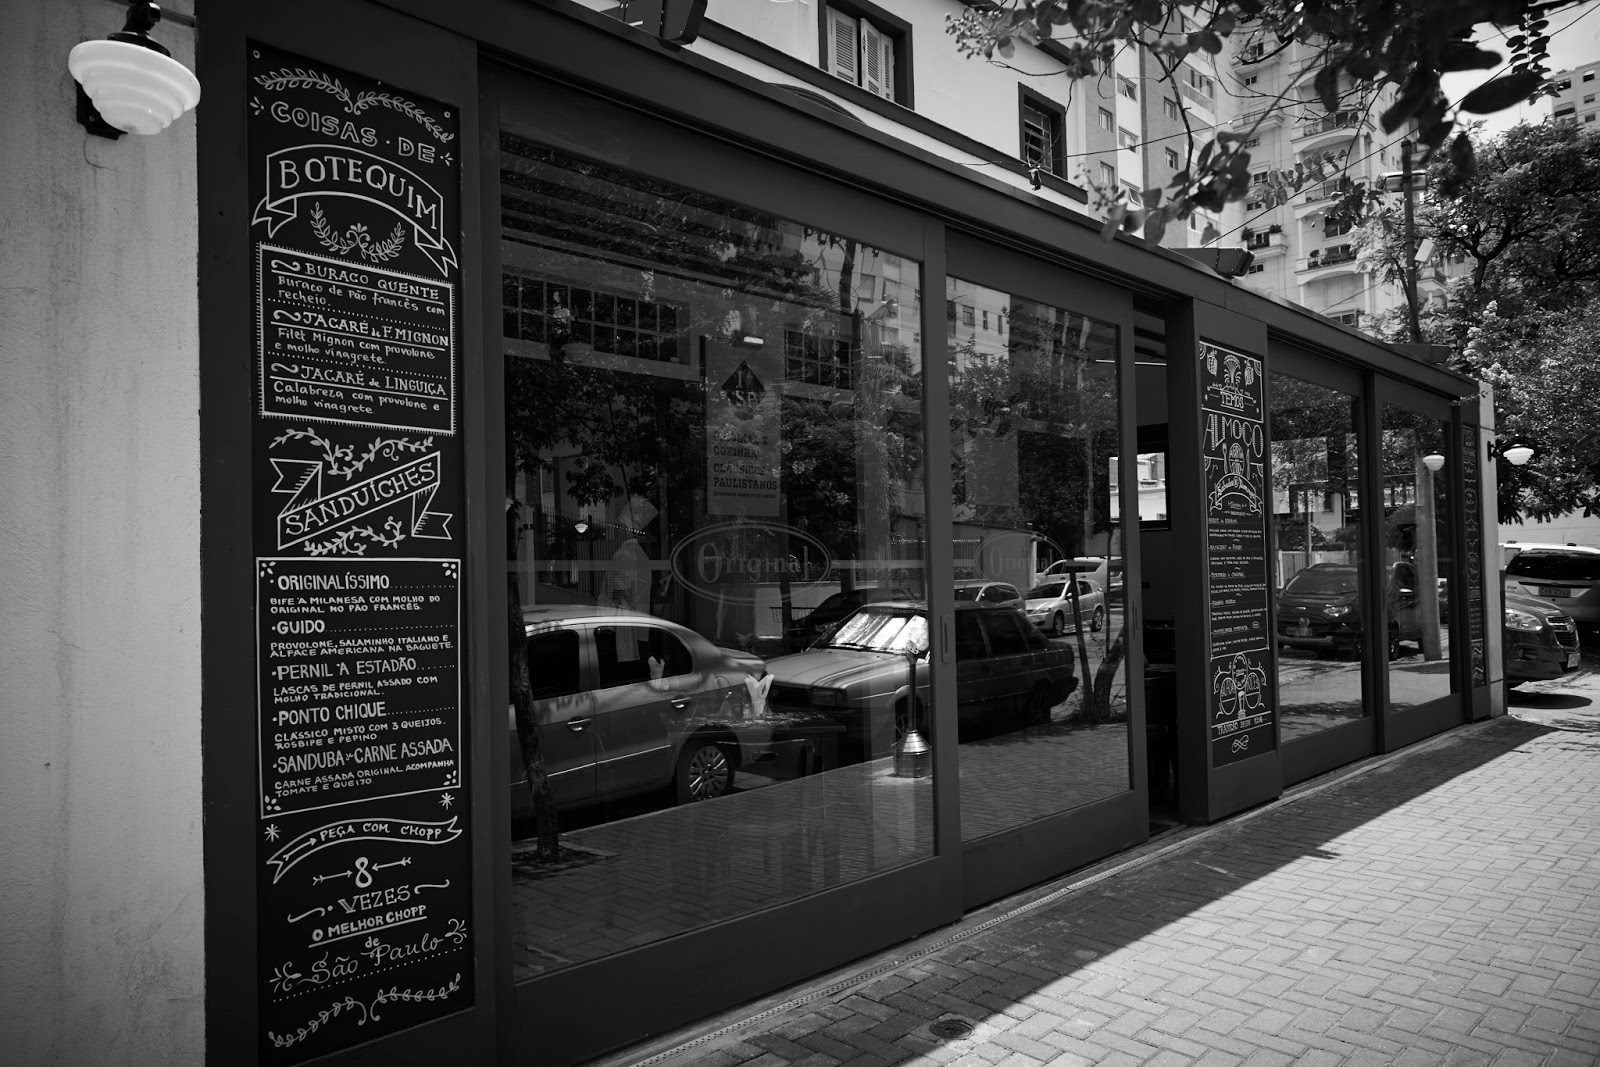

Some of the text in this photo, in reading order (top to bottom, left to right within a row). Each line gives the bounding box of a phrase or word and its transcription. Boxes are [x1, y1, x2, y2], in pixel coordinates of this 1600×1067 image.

[270, 101, 435, 164] COISAS DE
[279, 155, 437, 230] BOTEQUIM
[305, 263, 439, 300] BURACO QUENTE
[278, 276, 446, 316] Buraco de pão francês com
[278, 290, 331, 306] recheio.
[302, 312, 369, 334] JACARÉ
[371, 328, 381, 338] de
[274, 342, 387, 364] e molho vinagrete.
[278, 328, 436, 360] Filet Mignon com provolone
[301, 365, 446, 396] JACARÉ de LINGUIÇA
[274, 380, 440, 411] Calabreza com provolone e
[275, 395, 376, 414] molho vinagrete.
[714, 477, 777, 490] PAULISTANOS
[285, 462, 436, 535] SANDUÍCHES
[697, 543, 810, 583] Original
[989, 546, 1052, 577] Origal
[277, 572, 390, 591] ORIGINALÍSSIMO
[270, 597, 295, 606] BIFE
[310, 596, 366, 605] MILANESA
[369, 596, 389, 604] COM
[392, 595, 425, 603] MOLHO
[270, 606, 326, 614] ORIGINAL
[330, 605, 344, 613] NO
[276, 620, 326, 634] GUIDO
[270, 634, 449, 650] PROVOLONE, SALAMINHO ITALIANO E
[270, 649, 316, 658] ALFACE
[320, 646, 385, 656] AMERICANA
[406, 642, 454, 651] BAGUETE.
[276, 663, 334, 680] PERNIL
[356, 656, 416, 675] ESTADÃO
[273, 676, 438, 697] LASCAS DE PERNIL ASSADO COM
[274, 689, 384, 704] MOLHO TRADICIONAL.
[278, 701, 387, 726] PONTO CHIQUE
[274, 728, 328, 742] CLÁSSICO
[334, 726, 366, 736] MISTO
[368, 722, 388, 732] COM
[392, 722, 398, 730] 3
[274, 738, 323, 750] ROSBIFE
[338, 734, 378, 744] PEPINO
[277, 750, 346, 774] SANDUBA
[354, 744, 398, 764] CARNE
[400, 738, 454, 758] ASSADA
[274, 760, 454, 790] CARNE ASSADA ORIGINAL ACOMPANHA
[275, 786, 318, 798] TOMATE
[332, 778, 372, 788] QUEIJO
[320, 822, 442, 842] PEÇA COM CHOPP
[354, 856, 372, 888] 8
[338, 885, 411, 914] VEZES
[312, 904, 427, 942] O MELHOR CHOPP
[365, 936, 380, 948] de
[298, 933, 444, 984] São Paulo
